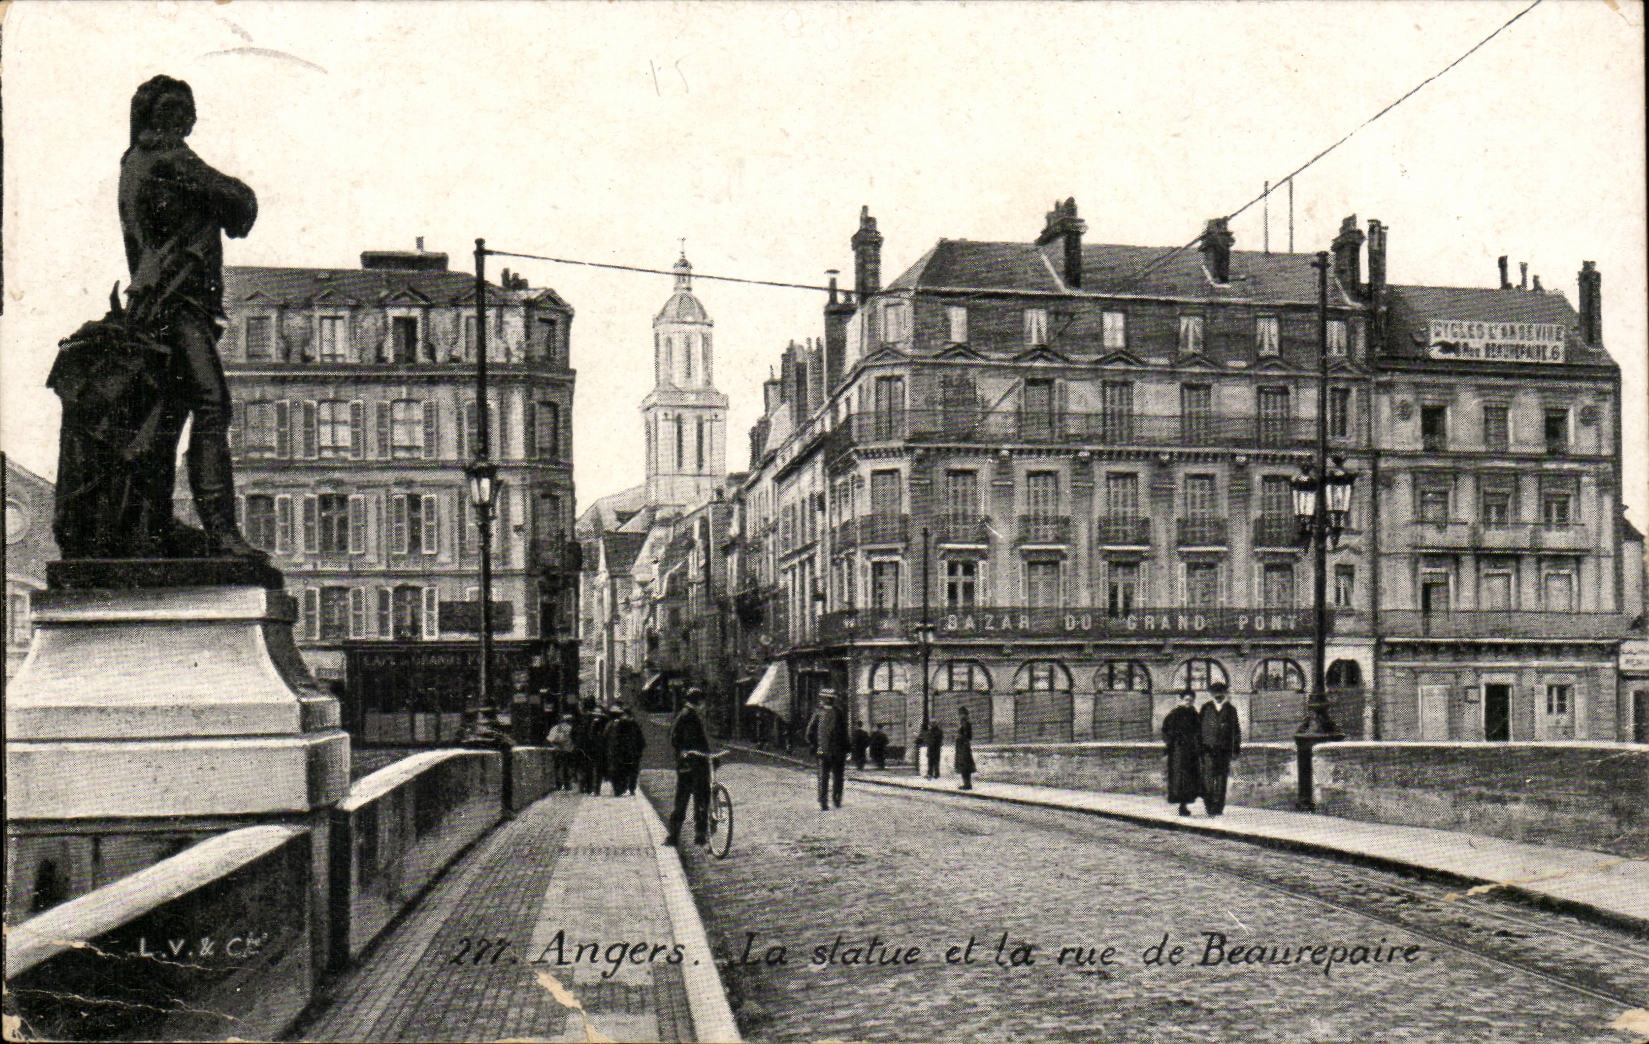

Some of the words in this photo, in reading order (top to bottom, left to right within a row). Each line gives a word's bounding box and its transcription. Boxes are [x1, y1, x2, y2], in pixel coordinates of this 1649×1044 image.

[948, 614, 1030, 631] BAZAR
[1064, 615, 1093, 631] DU
[1126, 615, 1206, 631] GRAND
[1238, 615, 1299, 631] PONT
